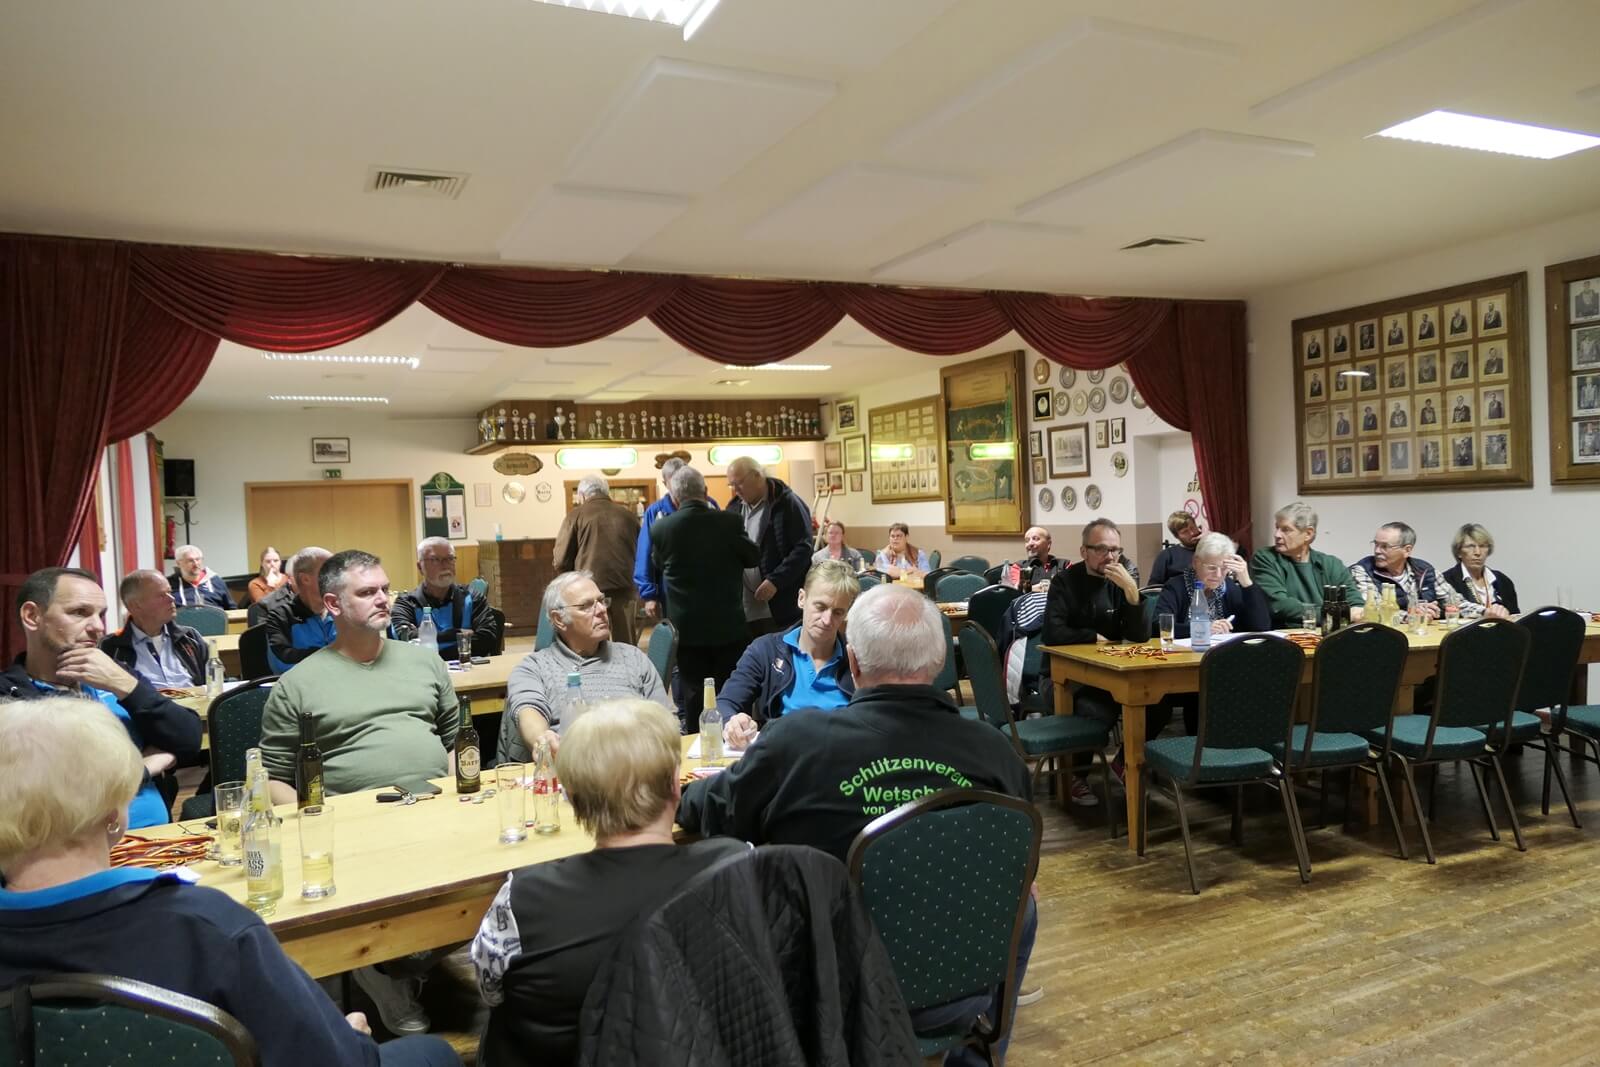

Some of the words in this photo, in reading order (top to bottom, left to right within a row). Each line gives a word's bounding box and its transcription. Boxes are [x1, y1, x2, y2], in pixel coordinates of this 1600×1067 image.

[839, 757, 973, 796] Schützenverein
[863, 785, 943, 802] Wetsch
[862, 805, 886, 815] von
